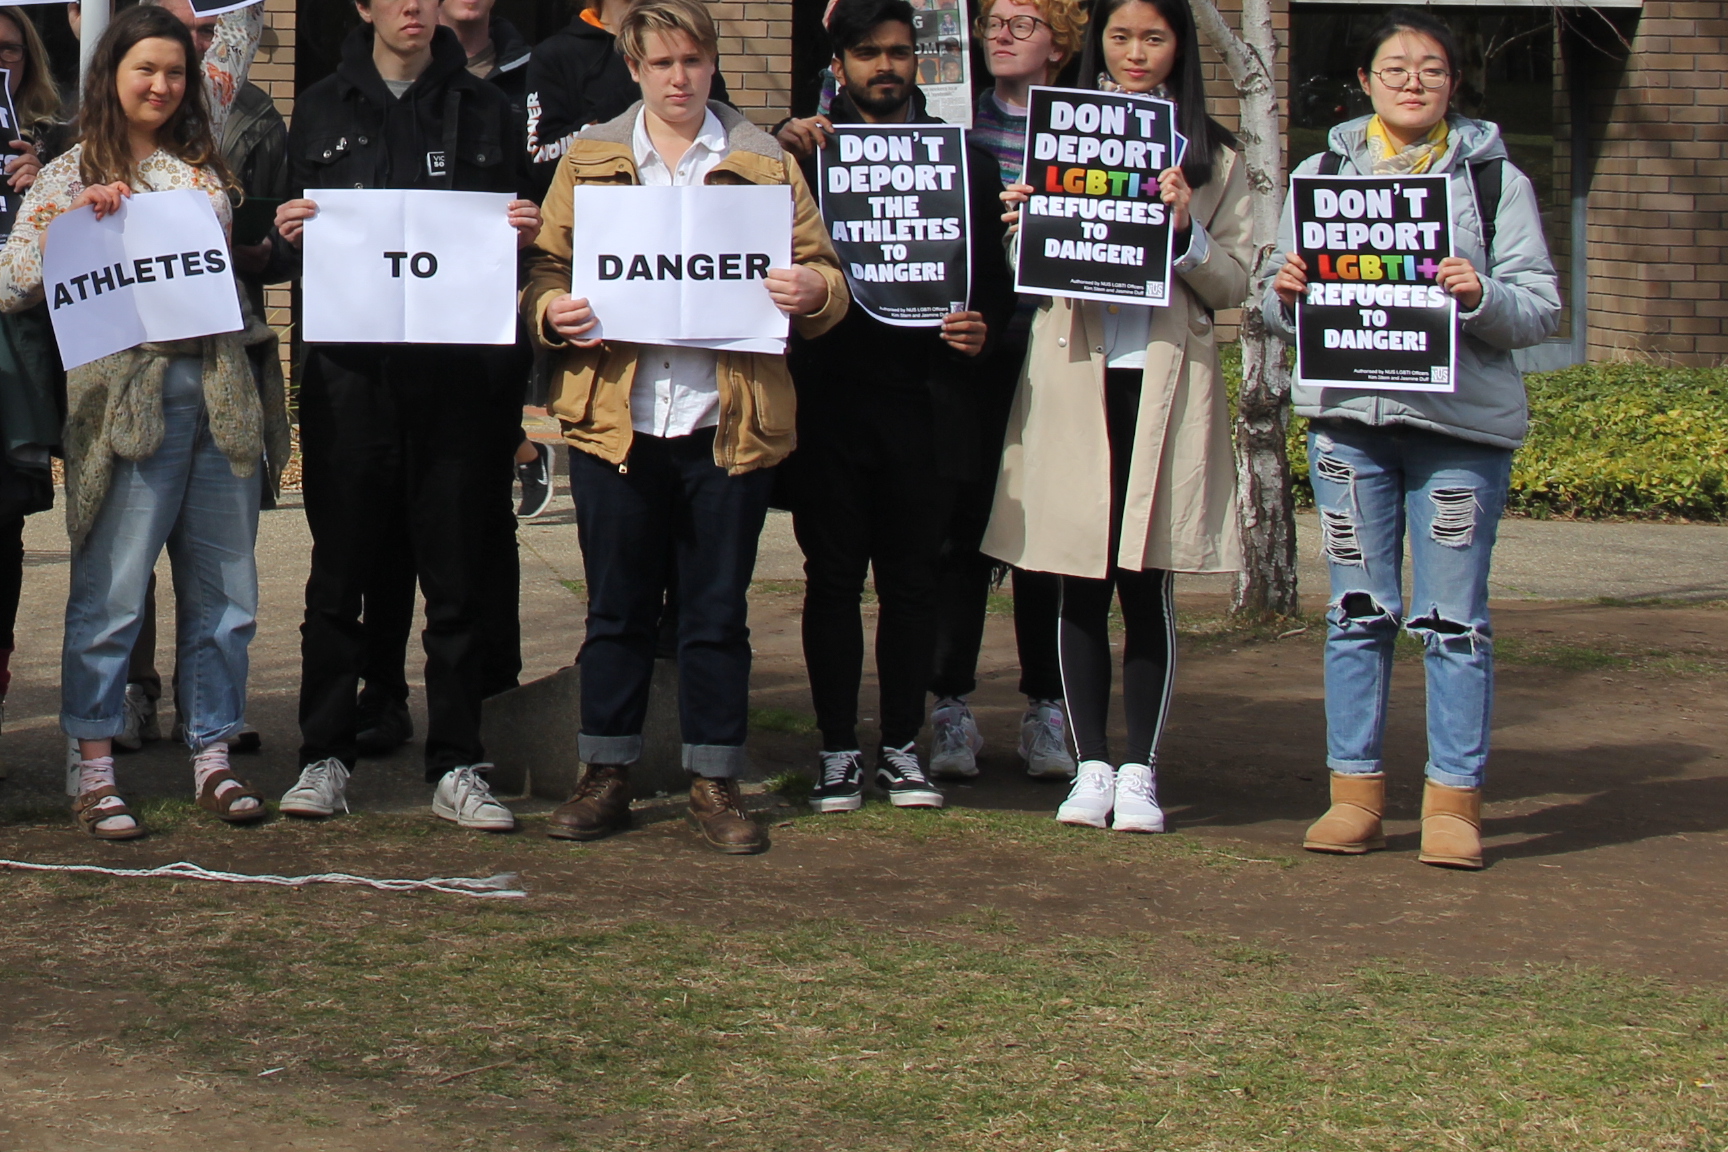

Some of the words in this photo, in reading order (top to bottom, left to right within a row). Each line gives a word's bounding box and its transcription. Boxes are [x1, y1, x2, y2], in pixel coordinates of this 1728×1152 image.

[1050, 101, 1156, 138] DON'T
[839, 132, 944, 162] DON'T
[1034, 133, 1165, 170] DEPORT
[828, 164, 956, 193] DEPORT
[1046, 165, 1161, 198] LGBTI+
[868, 195, 920, 219] THE
[1030, 195, 1164, 225] REFUGEES
[1313, 183, 1427, 219] DON'T
[832, 217, 961, 242] ATHLETES
[1081, 222, 1108, 240] TO
[1302, 222, 1440, 250] DEPORT
[383, 251, 439, 280] TO
[880, 244, 907, 261] TO
[1044, 238, 1144, 266] DANGER!
[52, 248, 227, 311] ATHLETES
[597, 252, 772, 283] DANGER
[850, 261, 945, 283] DANGER!
[1318, 254, 1438, 281] LGBTI+
[1306, 282, 1446, 308] REFUGEES
[1359, 309, 1387, 327] TO
[1324, 329, 1427, 351] DANGER!
